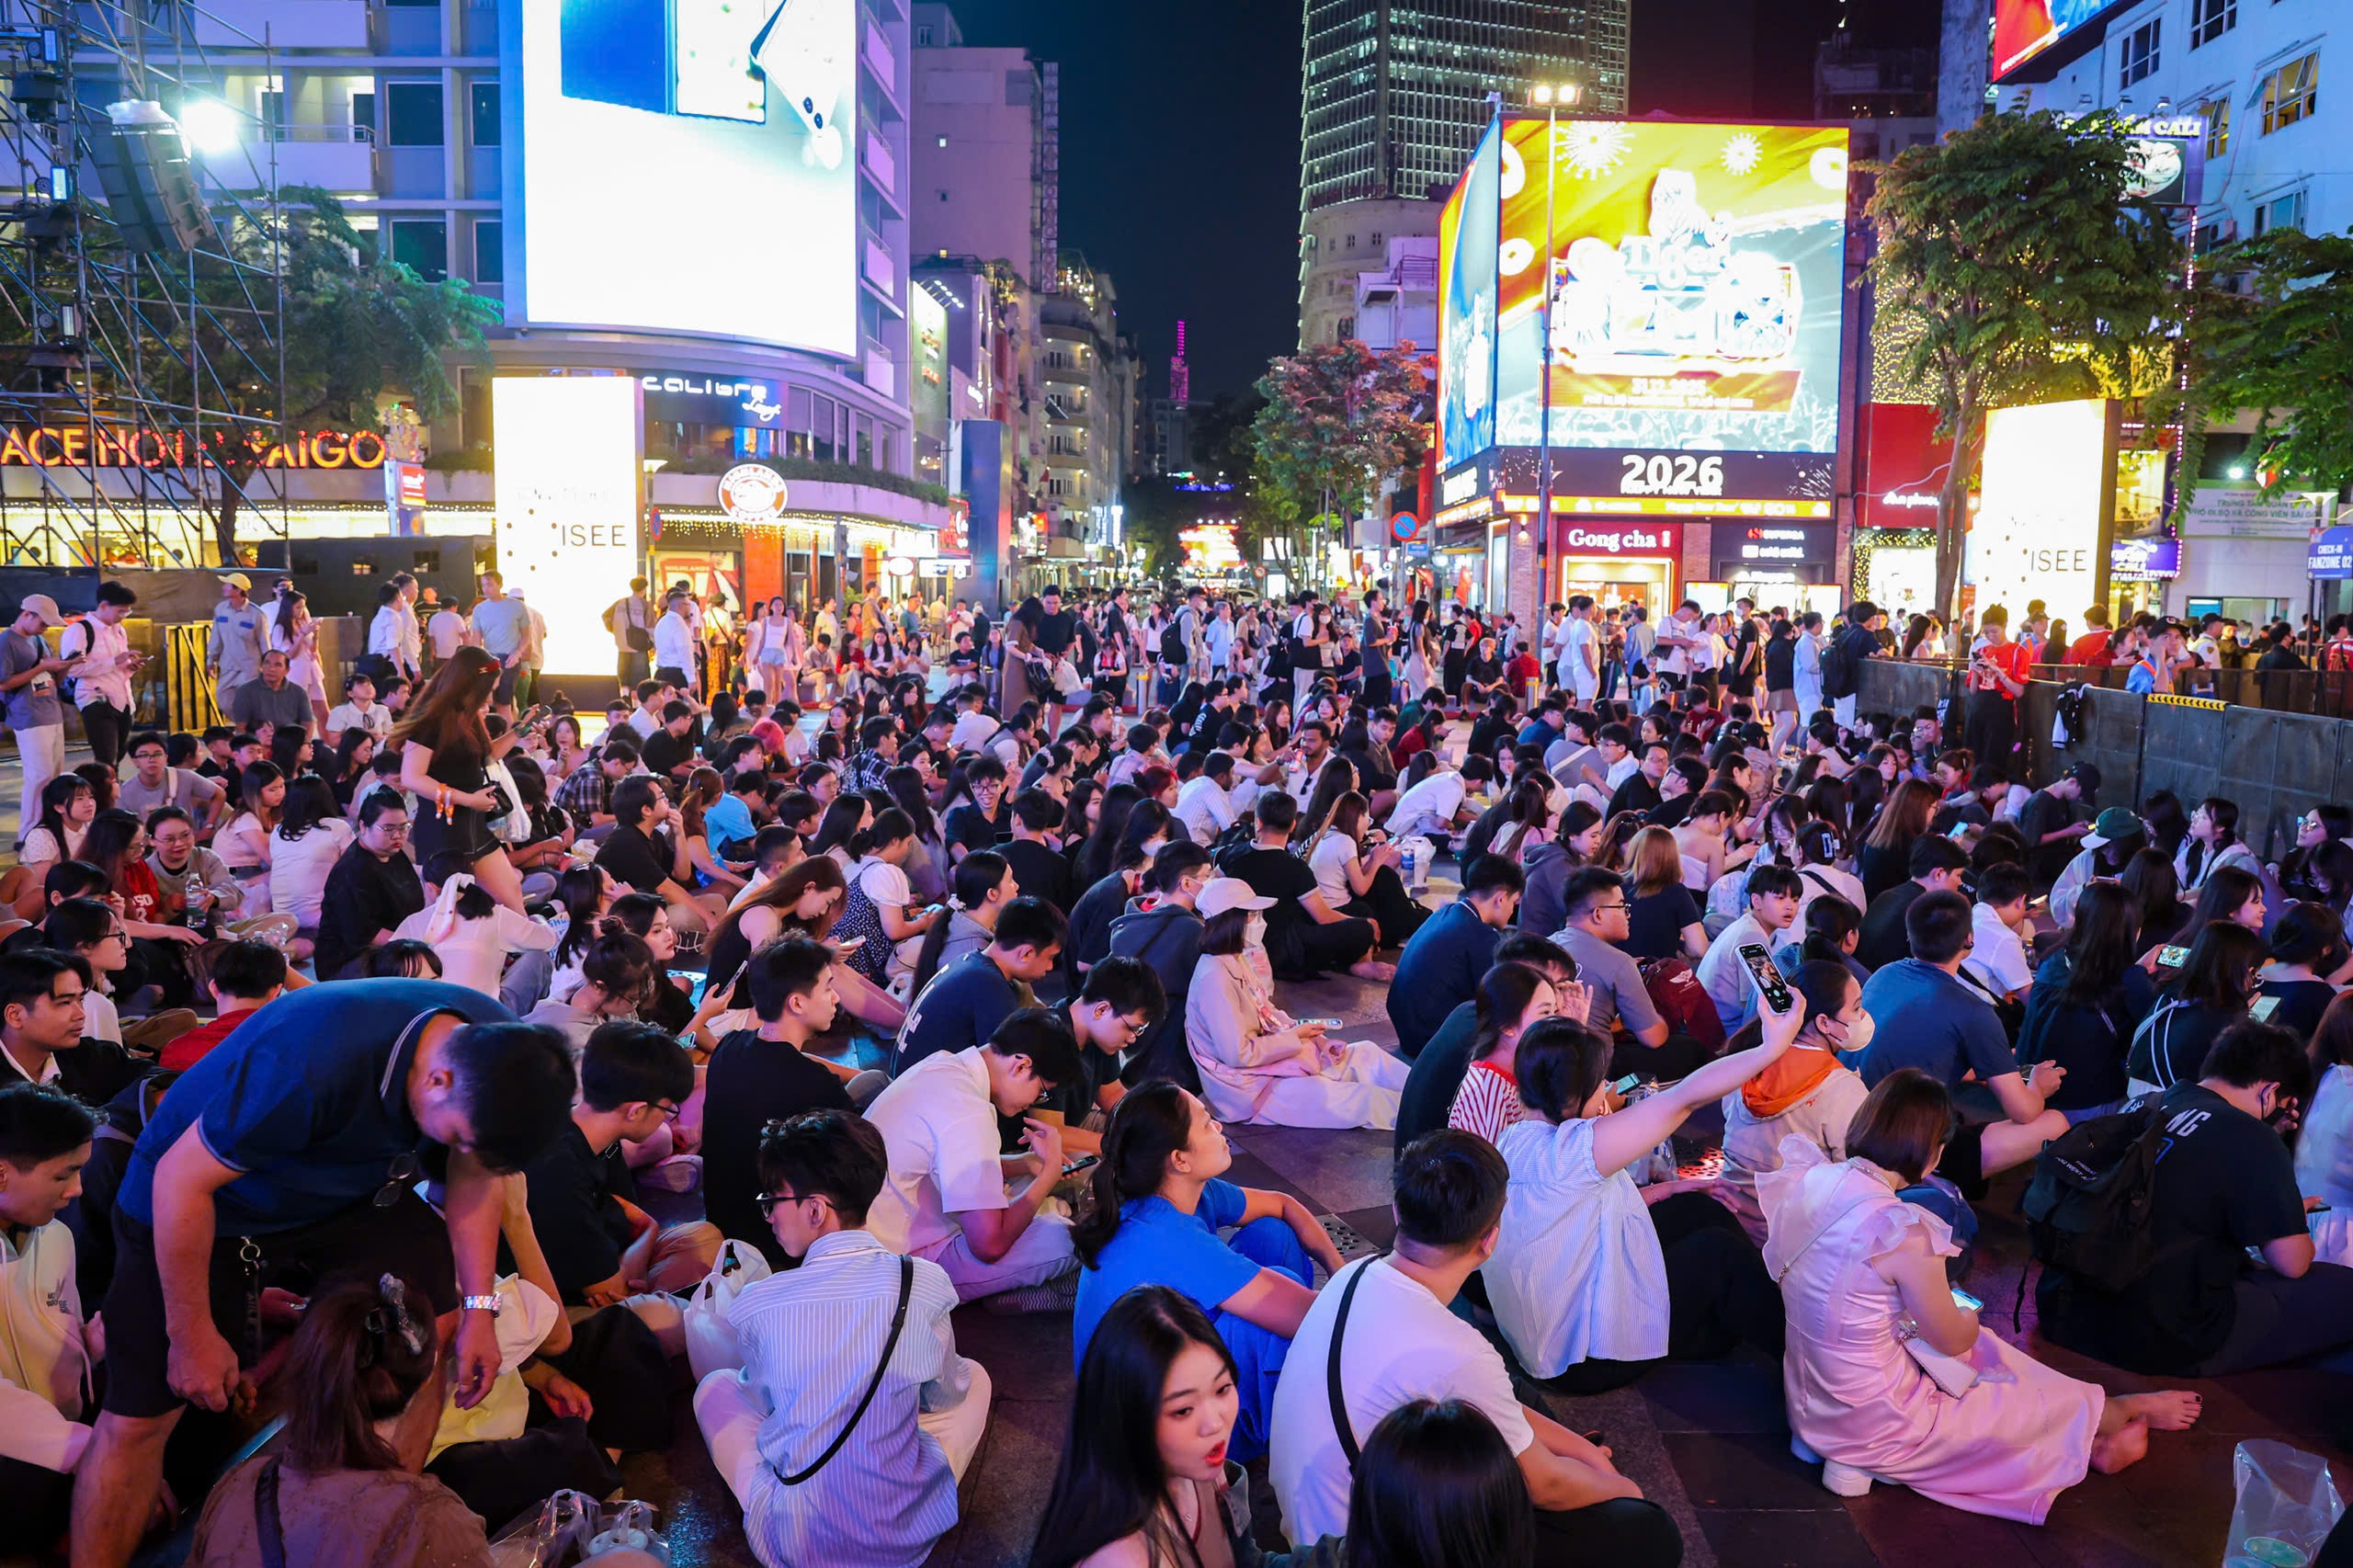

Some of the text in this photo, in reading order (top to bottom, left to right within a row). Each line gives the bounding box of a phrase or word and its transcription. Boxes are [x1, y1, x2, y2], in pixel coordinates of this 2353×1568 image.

[2154, 120, 2201, 136] CALI
[1620, 454, 1724, 490] 2026
[562, 524, 627, 547] ISEE
[1568, 528, 1620, 552] Gong
[1621, 529, 1657, 548] cha
[2317, 544, 2343, 555] CHECK-IN
[2030, 550, 2087, 572] ISEE
[2308, 555, 2353, 569] FANZONE 02
